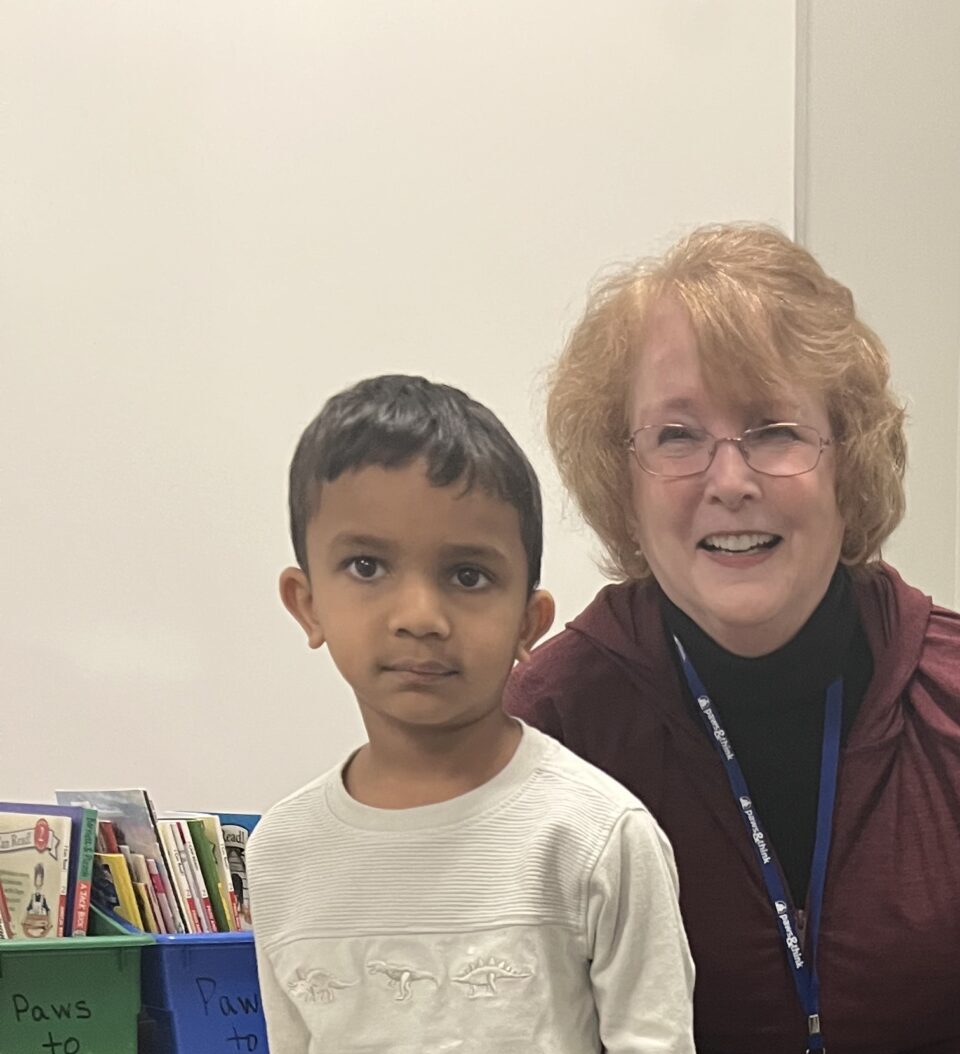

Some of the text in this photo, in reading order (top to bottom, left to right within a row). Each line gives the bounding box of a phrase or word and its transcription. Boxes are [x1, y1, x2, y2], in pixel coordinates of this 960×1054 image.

[12, 993, 92, 1022] Paws
[196, 977, 259, 1017] Paw
[226, 1026, 258, 1053] to
